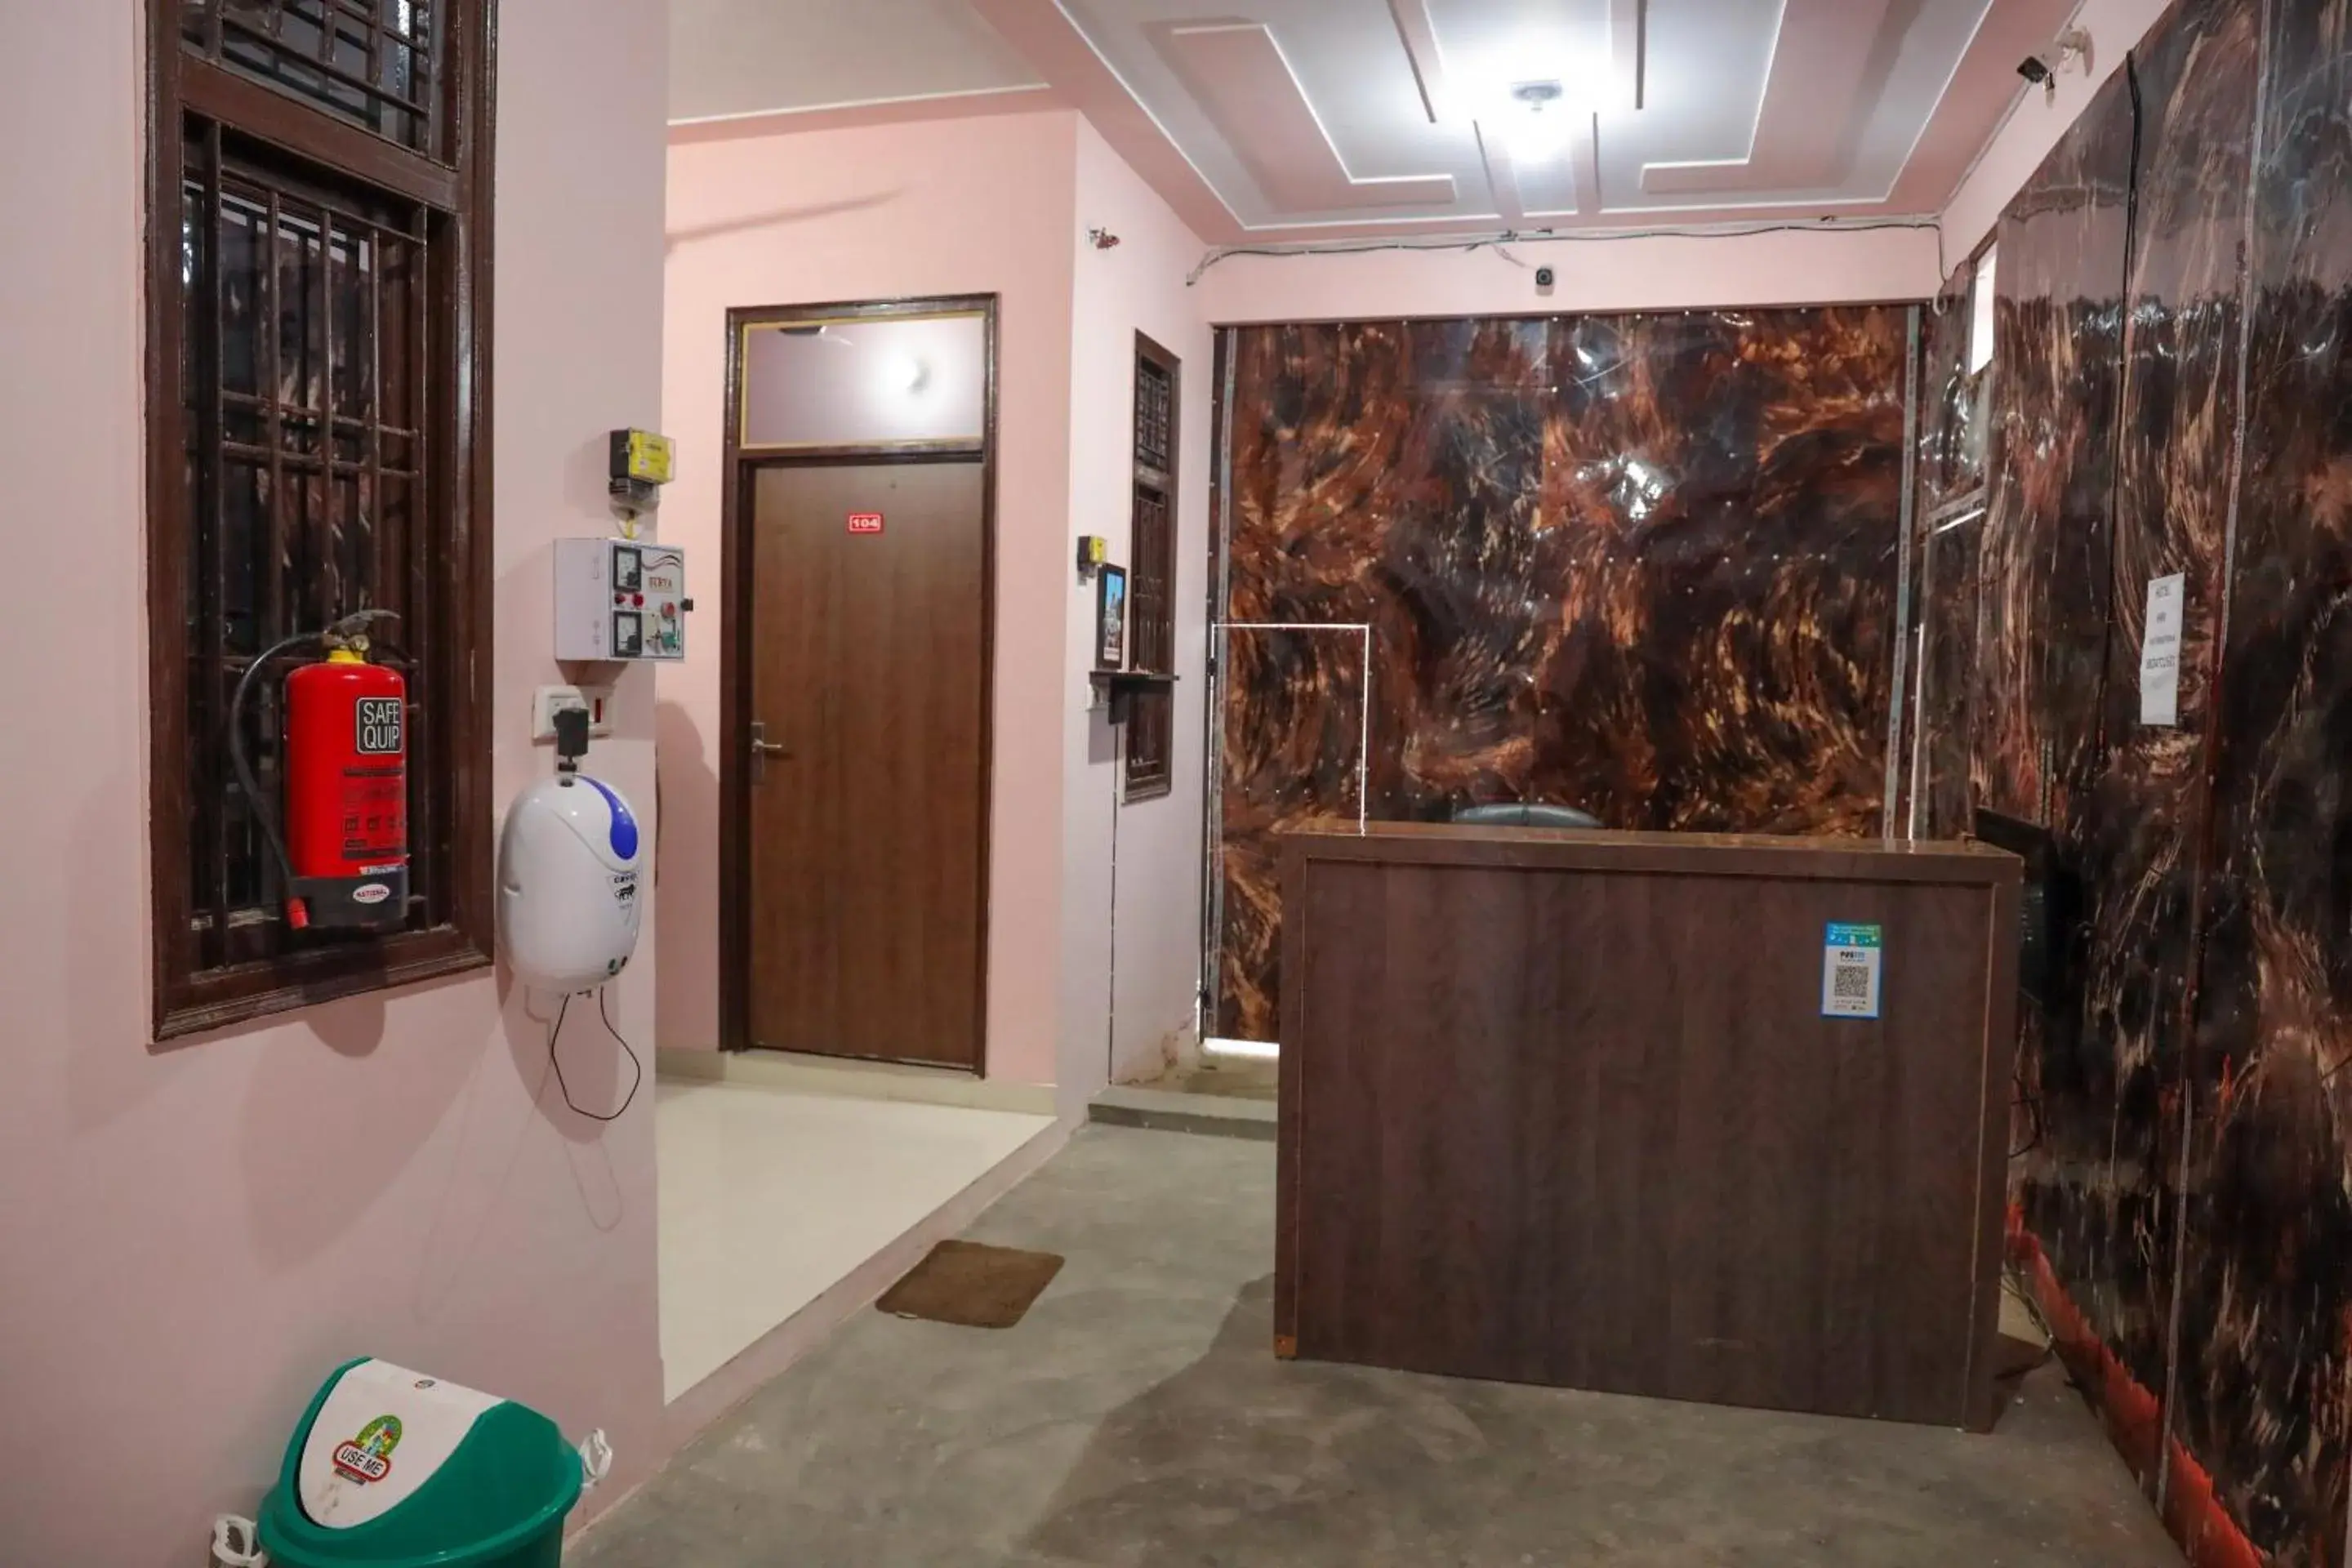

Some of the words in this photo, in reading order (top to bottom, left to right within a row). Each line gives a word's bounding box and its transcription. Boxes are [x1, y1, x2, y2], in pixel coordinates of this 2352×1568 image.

[853, 518, 878, 528] 104
[363, 702, 399, 725] SAFE
[364, 725, 399, 749] QUIP
[341, 1446, 366, 1467] USE
[362, 1459, 384, 1476] ME
